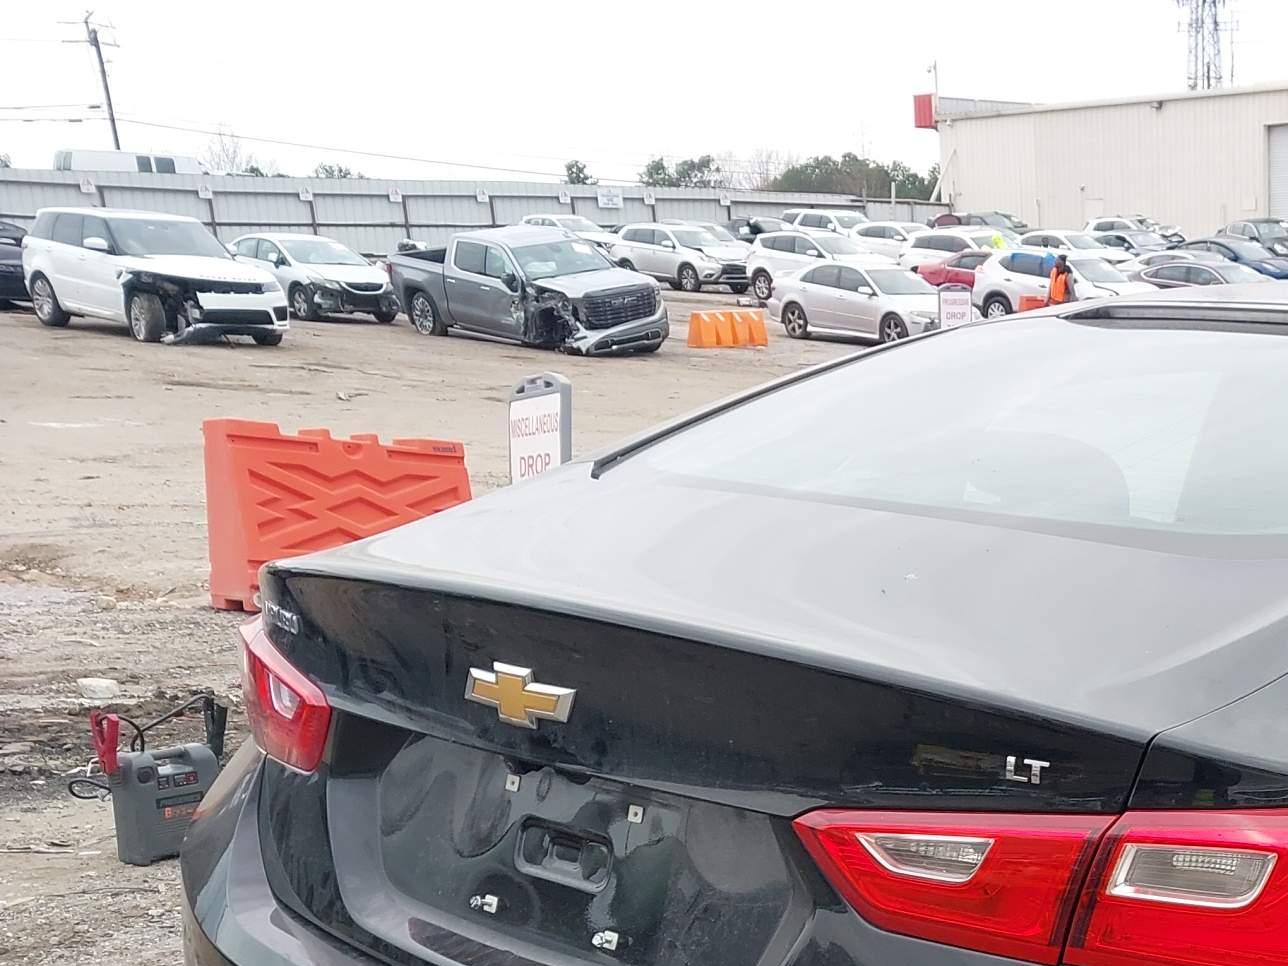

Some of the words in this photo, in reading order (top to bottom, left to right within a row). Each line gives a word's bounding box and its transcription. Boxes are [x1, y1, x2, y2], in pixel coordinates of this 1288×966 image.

[946, 311, 966, 320] DROP
[511, 412, 559, 438] MISCELLANEOUS
[520, 453, 551, 478] DROP
[1006, 755, 1050, 784] LT
